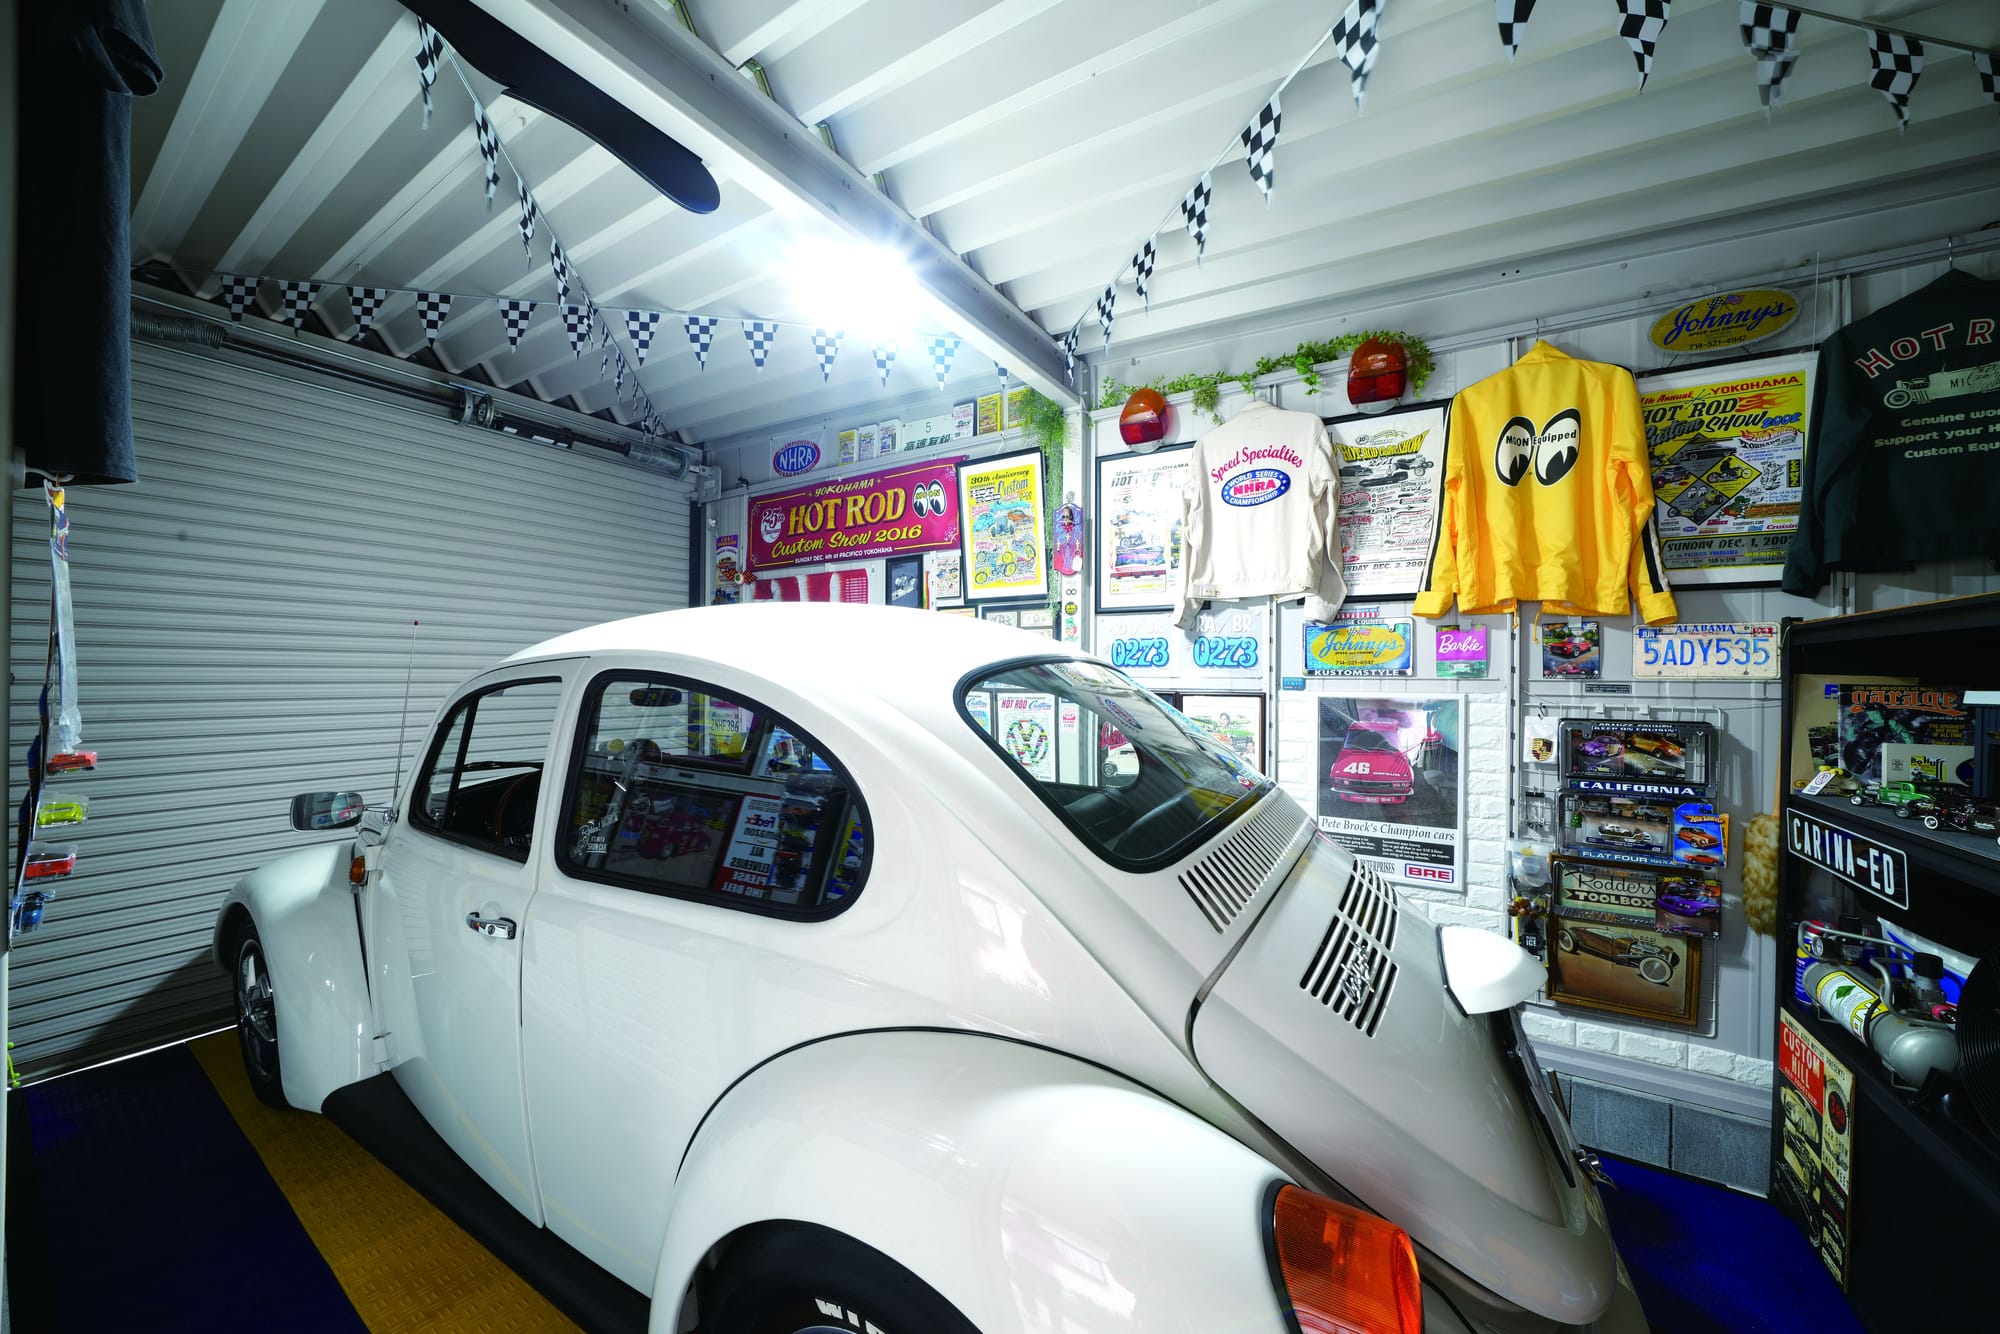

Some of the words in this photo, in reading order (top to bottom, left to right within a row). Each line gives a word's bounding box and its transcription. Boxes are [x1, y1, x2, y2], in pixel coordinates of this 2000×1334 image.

[1664, 301, 1793, 346] Johnny's
[1854, 322, 1955, 379] HOT
[1966, 317, 1996, 346] R
[1656, 390, 1694, 403] Annual
[1711, 375, 1800, 396] YOKOHAMA
[1687, 397, 1740, 419] ROD
[925, 421, 932, 434] 5
[1704, 410, 1768, 433] SHOW
[1901, 412, 1965, 428] Genuine
[1505, 434, 1530, 447] MOON
[1532, 429, 1577, 446] Equipped
[1874, 430, 1940, 448] Support
[1943, 425, 1984, 440] your
[779, 446, 813, 470] NHRA
[1904, 444, 1964, 459] Custom
[1210, 450, 1241, 484] Speed
[1241, 444, 1303, 469] Specialties
[814, 477, 874, 497] YOKOHAMA
[970, 475, 991, 485] 30th
[1227, 473, 1253, 487] WORLD
[1233, 479, 1277, 496] NHRA
[1229, 489, 1279, 505] CHAMPIONSHIP
[788, 499, 842, 537] HOT
[845, 487, 905, 528] ROD
[771, 536, 825, 559] Custom
[828, 527, 873, 549] Show
[875, 524, 923, 543] 2016
[1667, 539, 1714, 552] SUNDAY
[1718, 537, 1745, 549] DEC.
[839, 549, 863, 559] PACIFICO
[863, 546, 893, 556] YOKOHAMA
[1372, 562, 1392, 570] DEC.
[1641, 630, 1656, 638] JUN
[1676, 624, 1736, 635] ALABAMA
[1111, 636, 1170, 669] 0273
[1193, 635, 1259, 669] 0273
[1318, 630, 1404, 659] Johnny's
[1439, 634, 1484, 653] Barbie
[1644, 638, 1771, 666] 5ADY535
[1314, 669, 1400, 677] KUSTOMSTYLE
[1001, 699, 1014, 710] HOT
[1014, 698, 1028, 710] ROD
[1851, 690, 1966, 715] garage
[1343, 761, 1371, 775] 46
[1579, 781, 1695, 796] CALIFORNIA
[1321, 817, 1341, 829] Pete
[1343, 820, 1378, 833] Brock's
[1380, 824, 1432, 840] Champion
[1433, 831, 1455, 841] cars
[1582, 851, 1612, 859] FLAT
[1614, 853, 1648, 863] FOUR
[1793, 817, 1895, 895] CARINA-ED
[1408, 866, 1450, 881] BRE
[1574, 890, 1656, 909] TOOLBOX
[1525, 939, 1537, 947] ICE
[1783, 1027, 1820, 1079] CUSTOM
[1791, 1053, 1810, 1089] HILL
